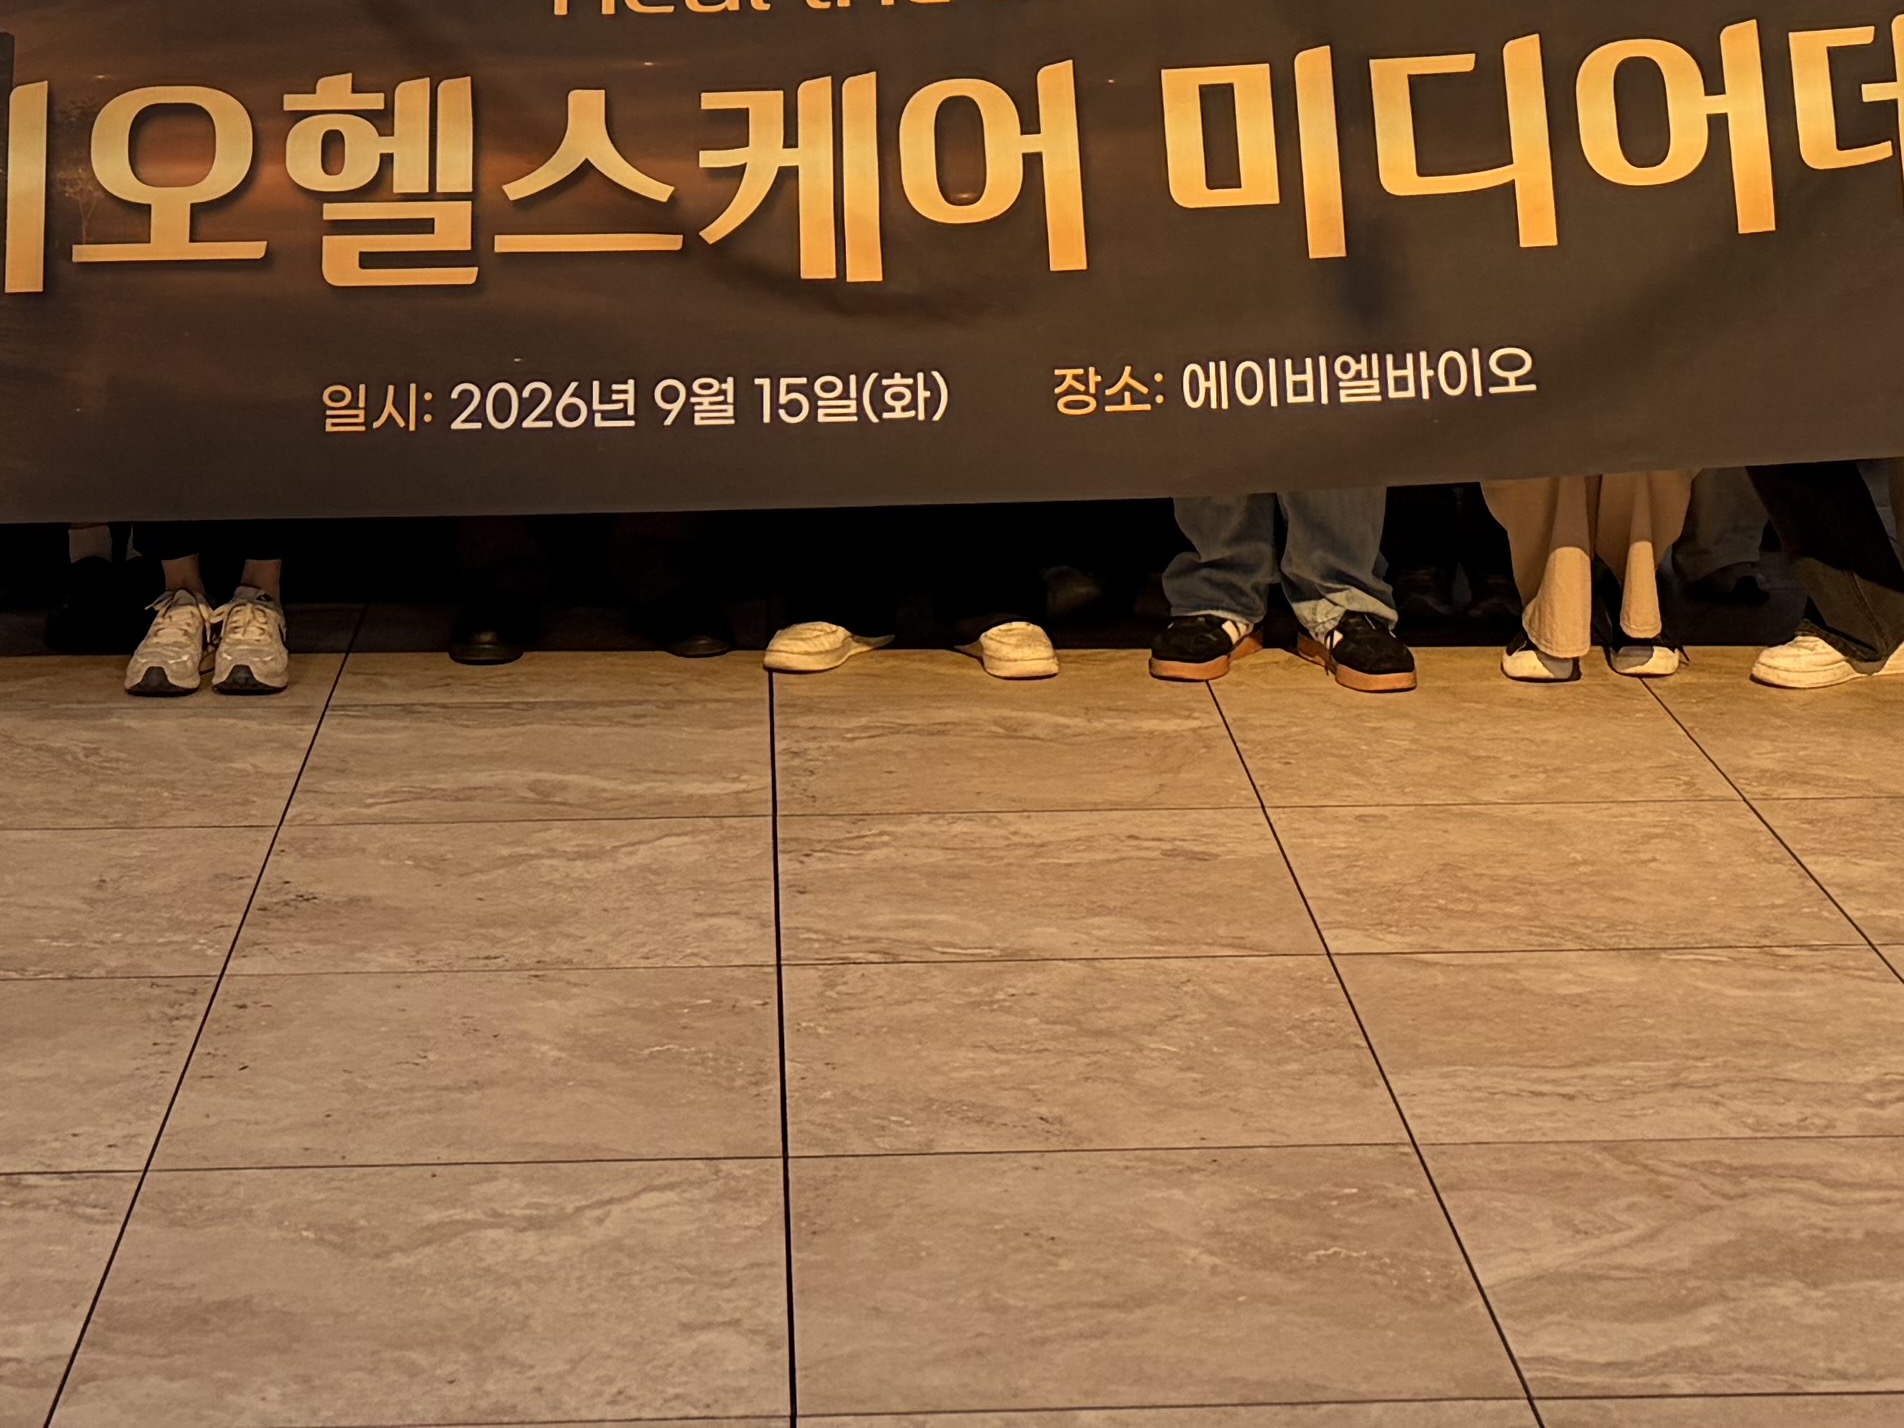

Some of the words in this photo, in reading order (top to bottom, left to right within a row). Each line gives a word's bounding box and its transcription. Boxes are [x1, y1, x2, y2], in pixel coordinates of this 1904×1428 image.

[322, 383, 433, 432] 일시:
[450, 378, 636, 430] 2026년
[654, 376, 736, 426] 9월
[753, 370, 949, 424] 15일(화)
[1053, 365, 1164, 416] 장소:
[1182, 347, 1537, 410] 에이비엘바이오
